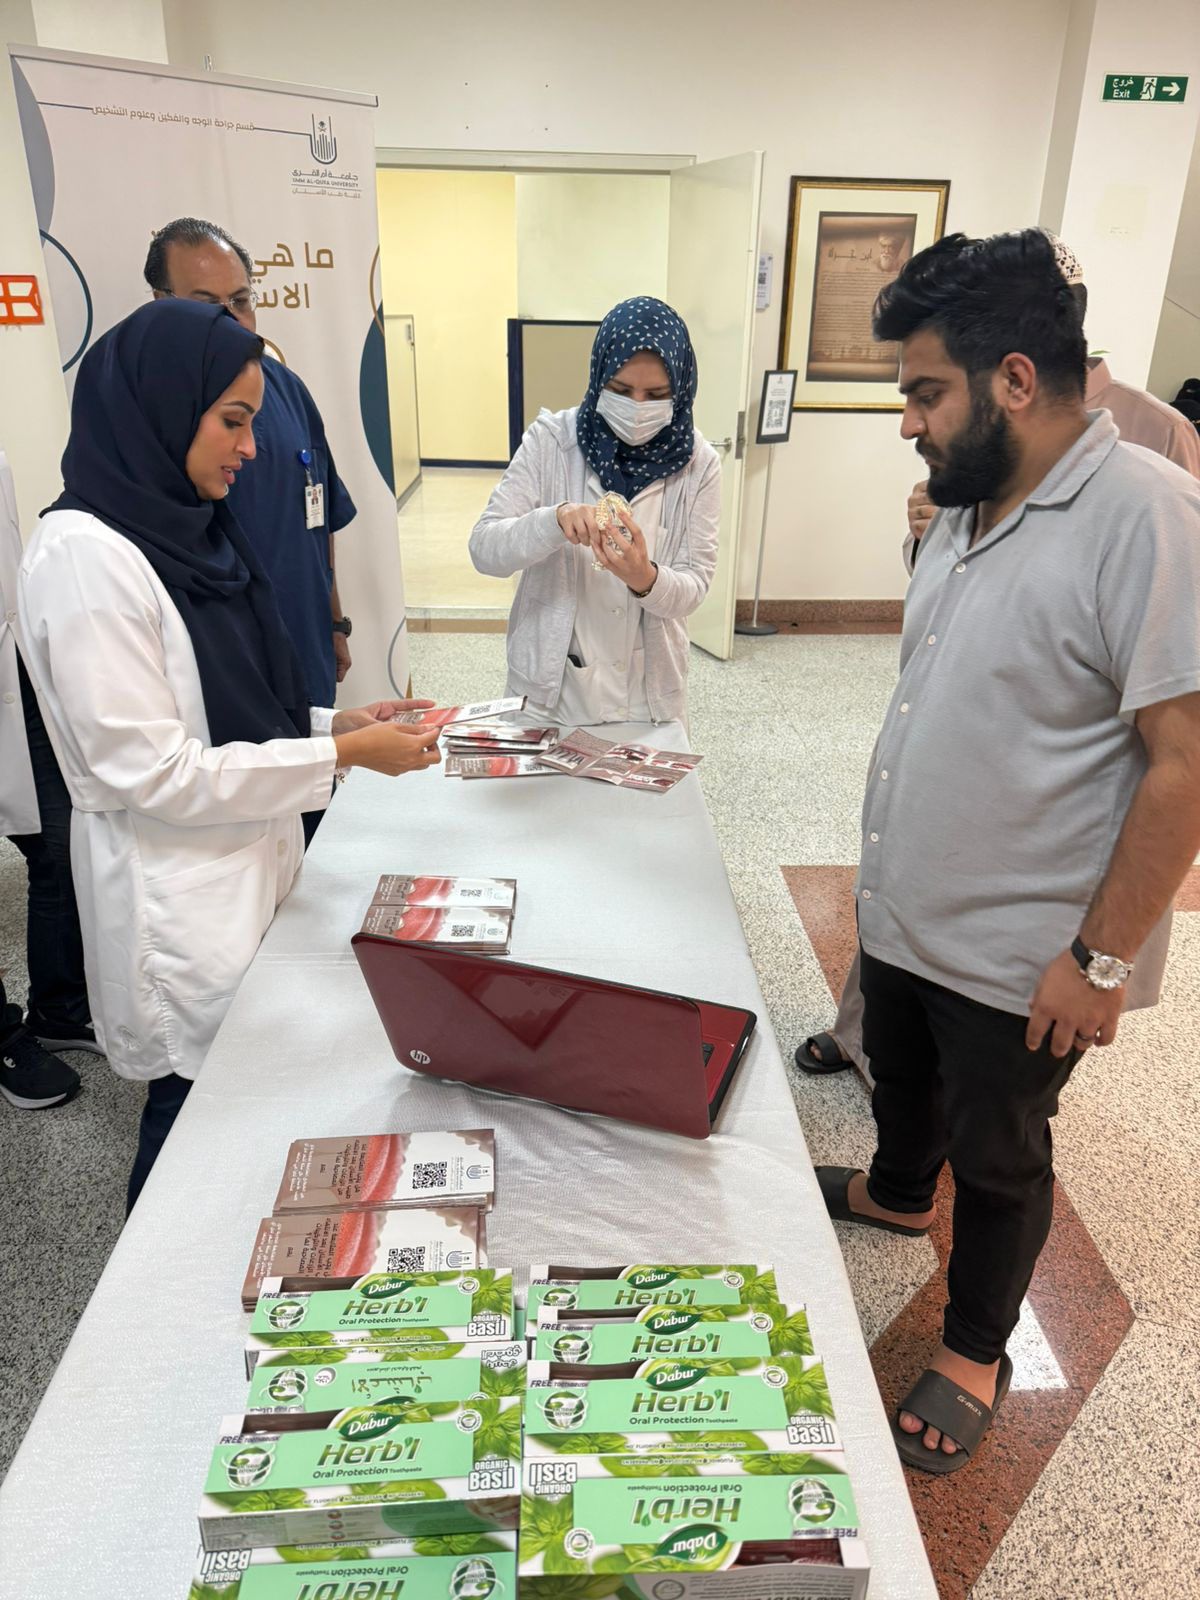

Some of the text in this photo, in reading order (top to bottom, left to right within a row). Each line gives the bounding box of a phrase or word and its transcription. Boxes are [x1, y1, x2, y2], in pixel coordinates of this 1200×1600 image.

[1112, 77, 1134, 87] خروج
[1113, 89, 1130, 98] Exit
[305, 242, 334, 268] ما
[411, 1050, 431, 1064] hp
[635, 1272, 670, 1285] Dabur
[368, 1281, 405, 1294] Dabur
[358, 1317, 401, 1325] Protection
[540, 1323, 561, 1331] FREE
[653, 1315, 691, 1329] Dabur
[467, 1320, 506, 1336] Basil
[655, 1369, 698, 1385] Dabur
[348, 1416, 393, 1435] Dabur
[629, 1416, 650, 1424] Oral
[652, 1416, 704, 1424] Protection
[790, 1415, 825, 1425] ORGANIC
[219, 1435, 244, 1444] FREE
[786, 1423, 835, 1444] Basil
[474, 1459, 509, 1471] ORGANIC
[312, 1470, 334, 1479] Oral
[335, 1466, 388, 1477] Protection
[468, 1466, 515, 1491] Basil
[529, 1462, 577, 1486] Basil
[534, 1483, 572, 1495] ORGANIC
[663, 1484, 718, 1493] Protection
[720, 1484, 742, 1492] Oral
[833, 1528, 858, 1537] FREE
[669, 1532, 718, 1554] Dabur
[201, 1549, 253, 1576] Basil
[204, 1570, 242, 1583] ORGANIC
[330, 1566, 385, 1577] Protection
[386, 1565, 408, 1575] Oral
